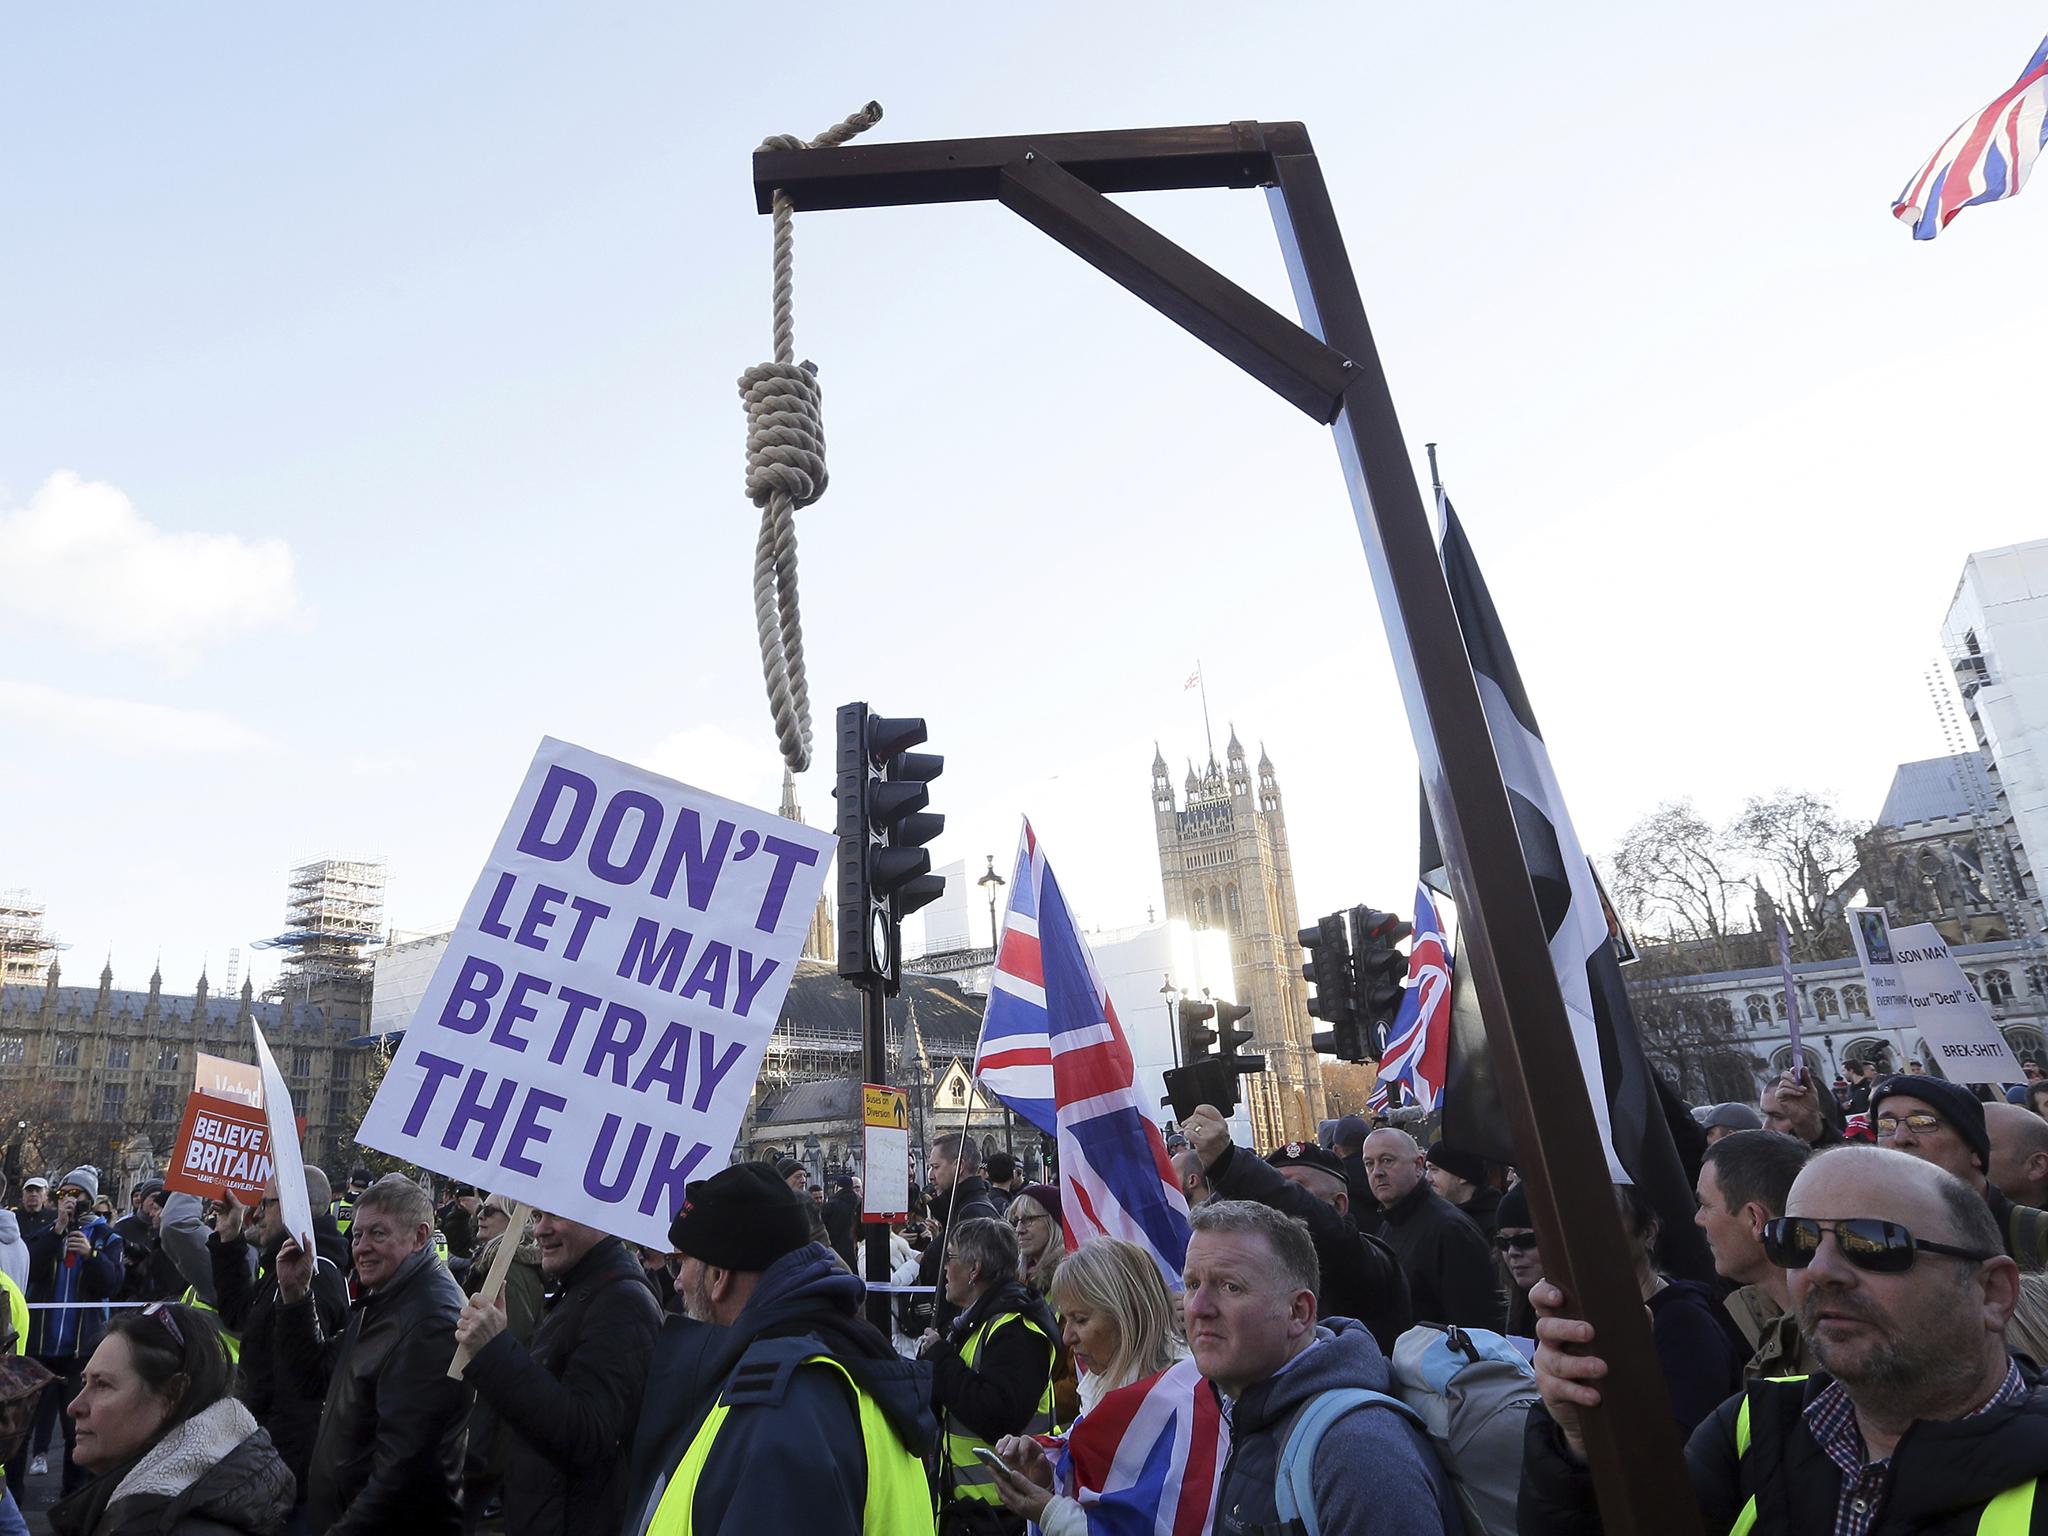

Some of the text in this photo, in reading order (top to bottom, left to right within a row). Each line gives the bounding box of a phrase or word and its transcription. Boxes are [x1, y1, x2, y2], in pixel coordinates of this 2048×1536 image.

[516, 764, 819, 934] DON'T
[478, 872, 780, 1017] LET MAY
[1924, 946, 1948, 960] MAY
[1908, 997, 1930, 1007] Your
[1965, 991, 1976, 1003] is
[437, 955, 747, 1113] BETRAY
[1943, 1044, 2003, 1056] BREX-SHIT!
[866, 1094, 881, 1104] Buses
[867, 1107, 889, 1118] Diversion
[194, 1116, 264, 1151] BELIEVE
[401, 1051, 712, 1223] THE UK
[186, 1140, 274, 1182] BRITAIN
